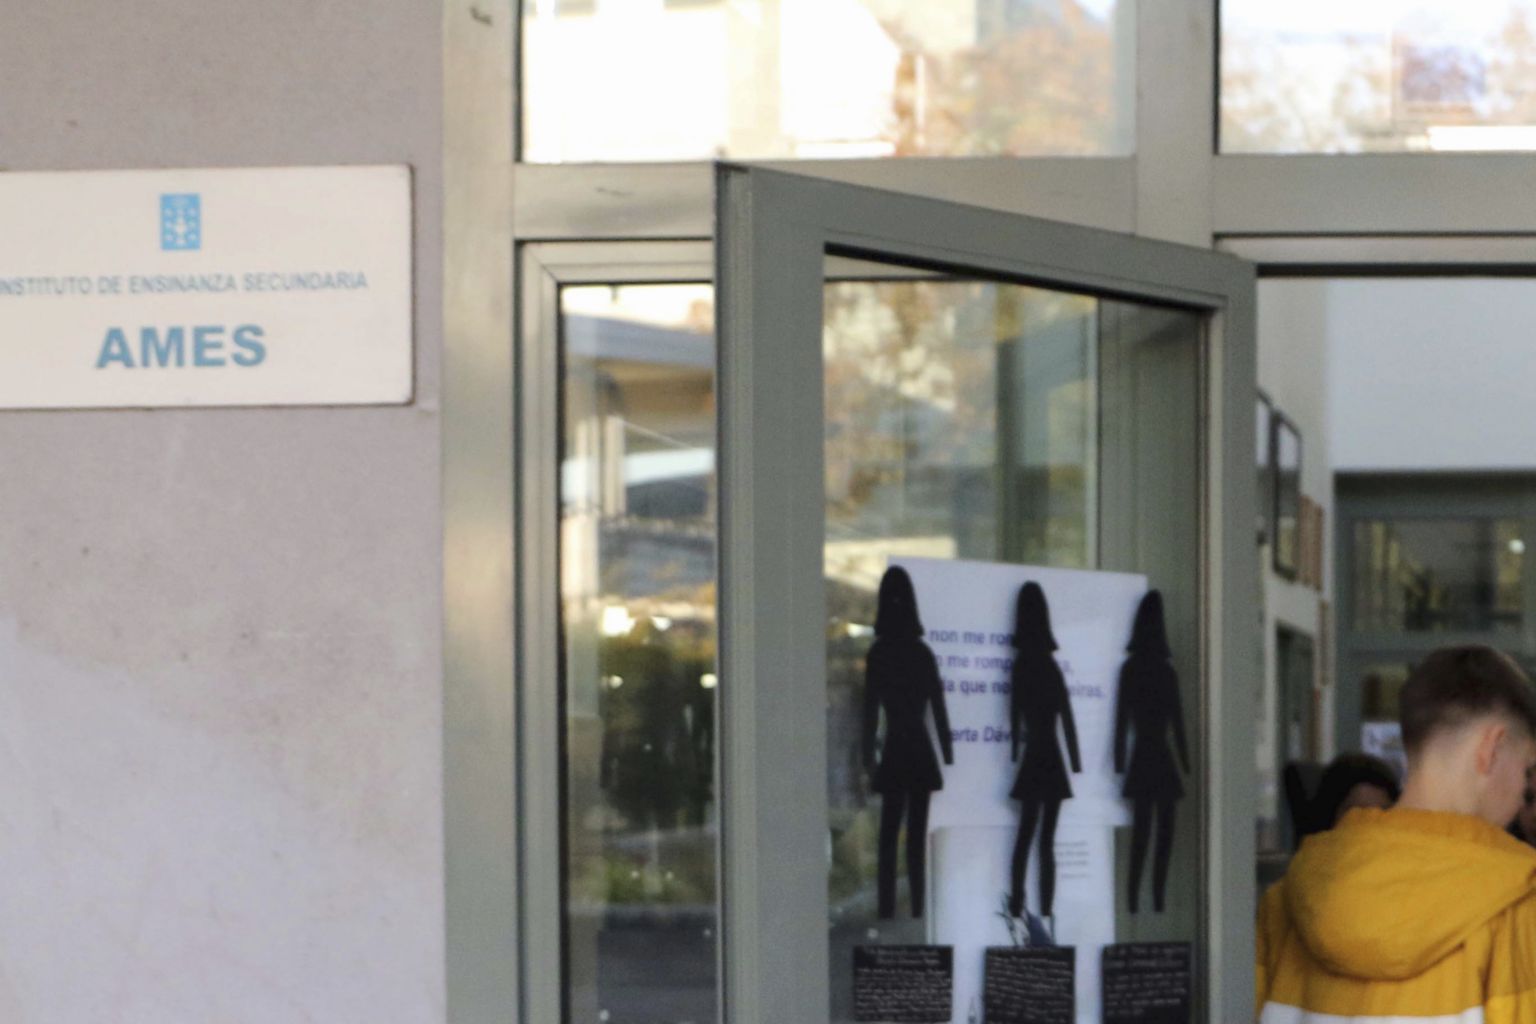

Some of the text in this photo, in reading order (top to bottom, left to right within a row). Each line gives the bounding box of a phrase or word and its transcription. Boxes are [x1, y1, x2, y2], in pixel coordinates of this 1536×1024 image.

[0, 271, 367, 295] NSTITUTO DE ENSINANZA SECUNDARIA
[96, 325, 266, 369] AMES
[929, 630, 958, 643] non
[963, 631, 985, 645] me
[947, 656, 969, 668] me
[960, 681, 987, 696] que
